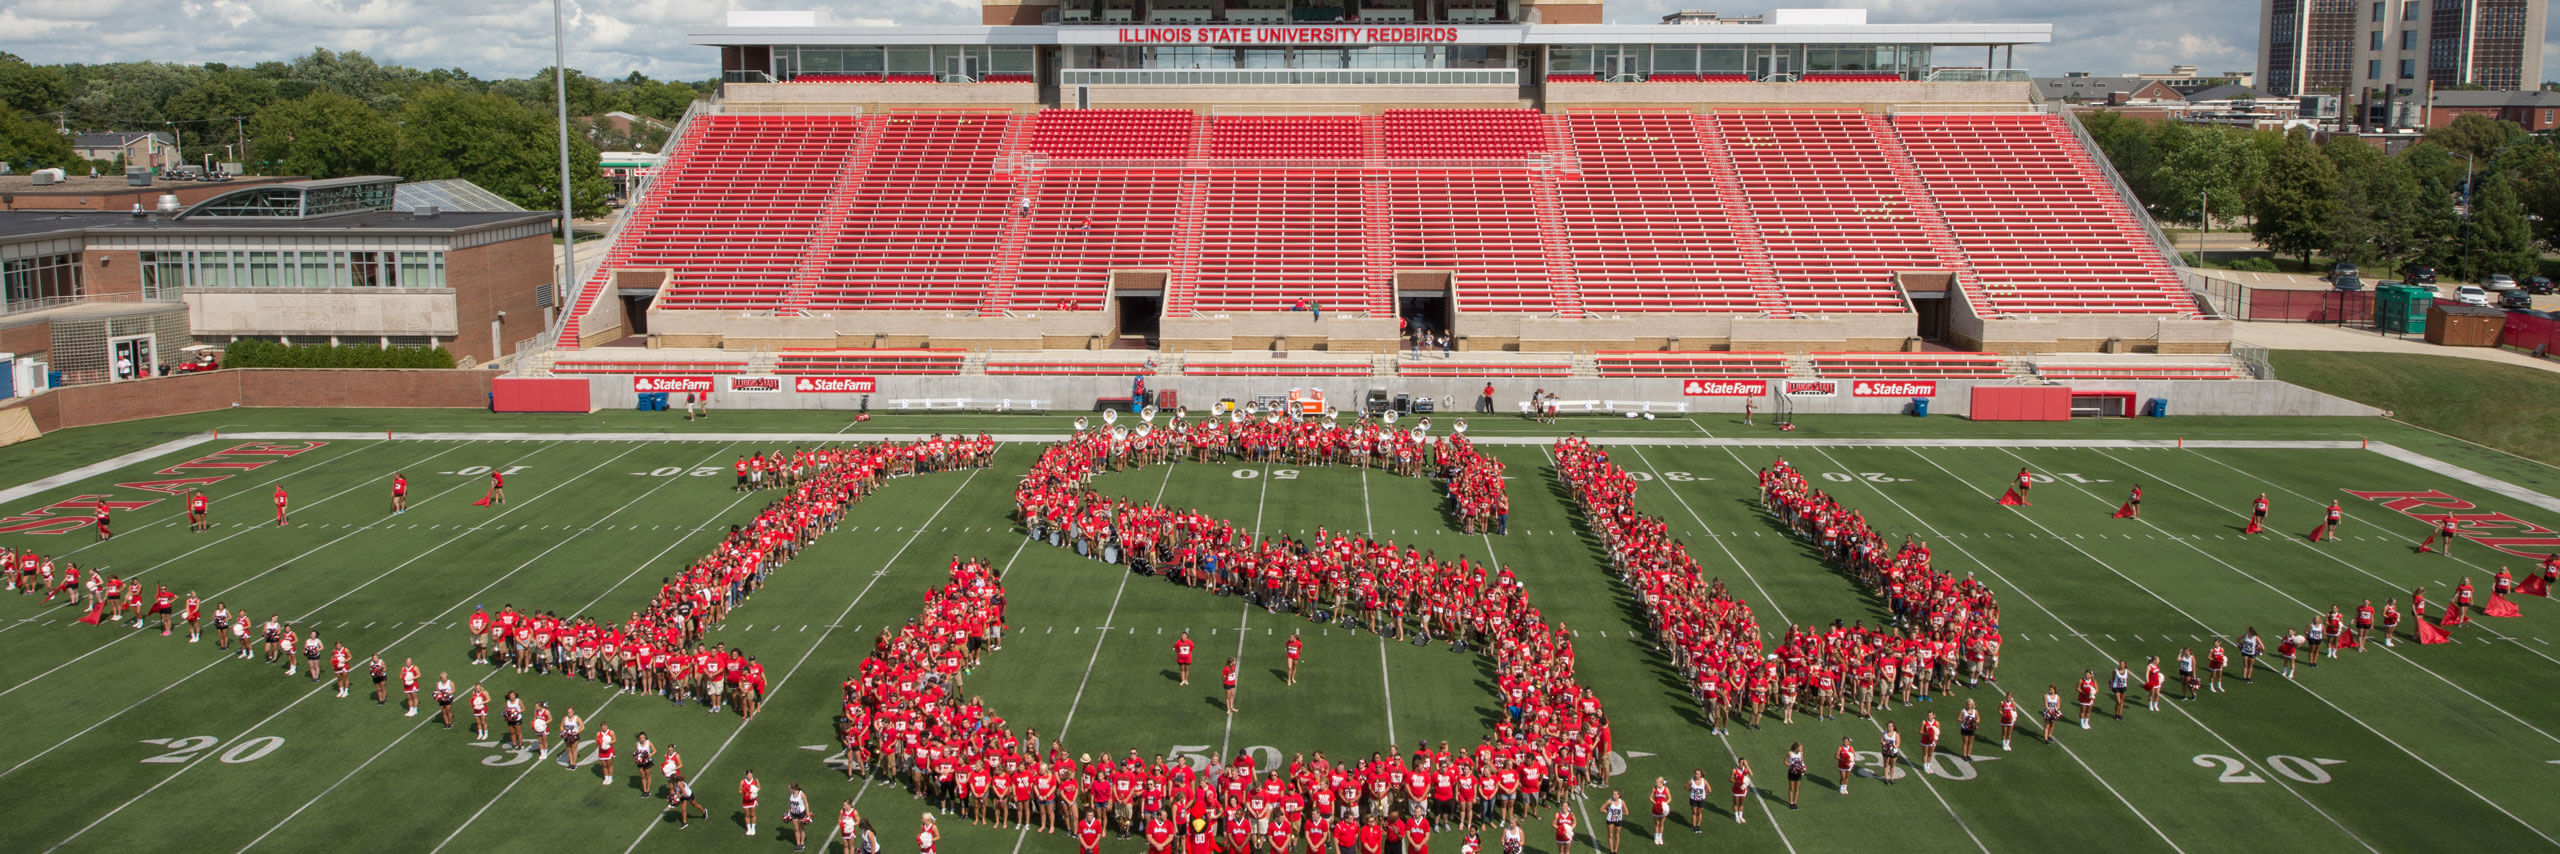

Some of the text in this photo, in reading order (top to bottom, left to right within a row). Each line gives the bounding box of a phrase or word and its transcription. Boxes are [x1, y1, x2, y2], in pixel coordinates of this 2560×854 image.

[1119, 27, 1458, 42] ILLINOIS STATE UNIVERSITY REDBIRDS
[139, 735, 286, 764] 20
[2192, 753, 2332, 784] 20
